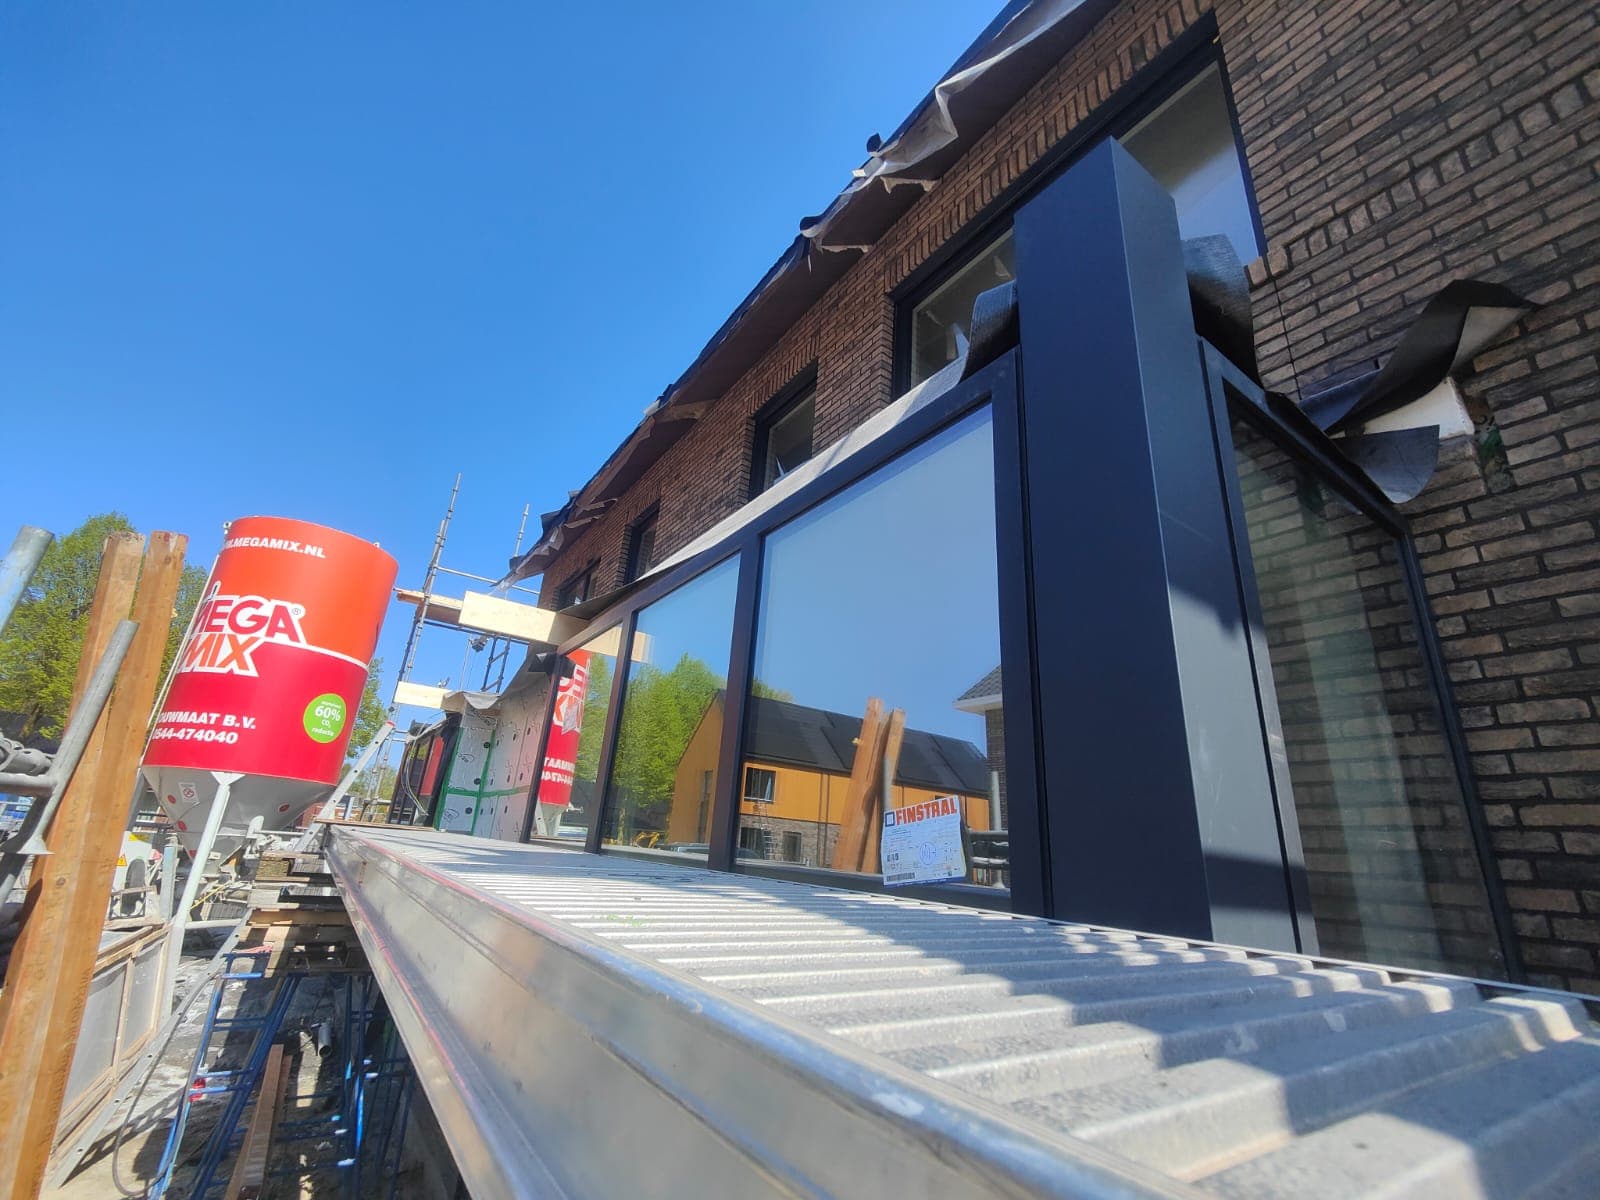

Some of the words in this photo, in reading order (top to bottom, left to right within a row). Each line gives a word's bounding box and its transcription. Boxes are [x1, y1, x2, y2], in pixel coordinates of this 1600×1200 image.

[315, 705, 341, 721] 60%
[222, 714, 257, 729] B.V.
[895, 798, 957, 825] FINSTRAL
